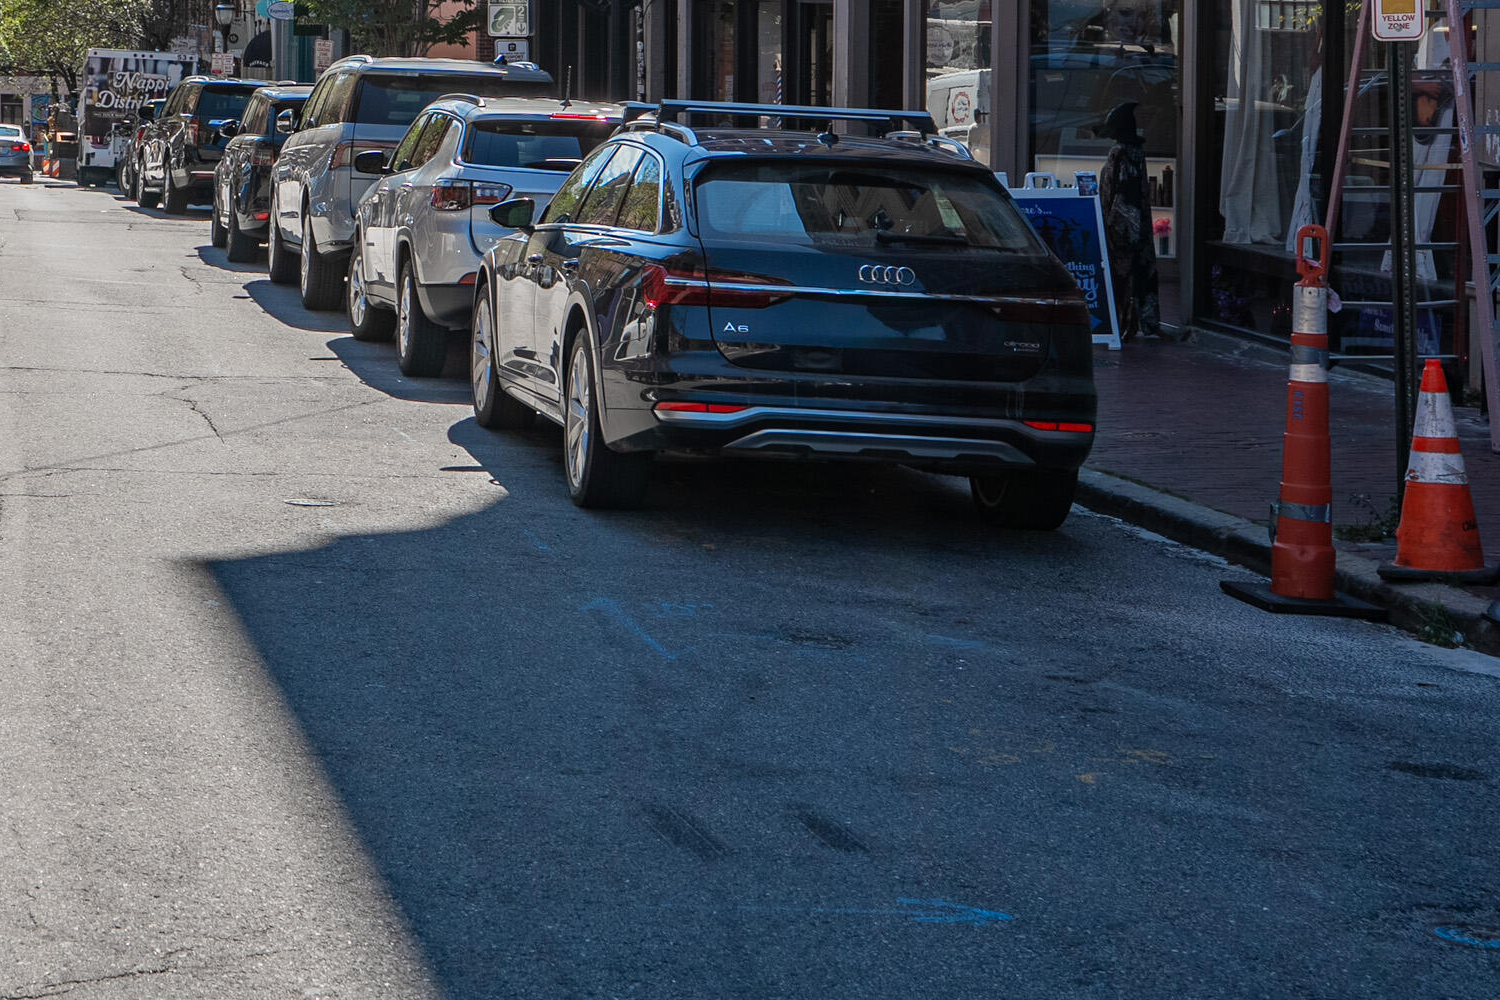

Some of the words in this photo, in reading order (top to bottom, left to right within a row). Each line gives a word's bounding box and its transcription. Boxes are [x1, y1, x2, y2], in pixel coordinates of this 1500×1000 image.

[518, 6, 525, 16] 2
[113, 72, 171, 92] Nappi
[723, 321, 749, 333] A6
